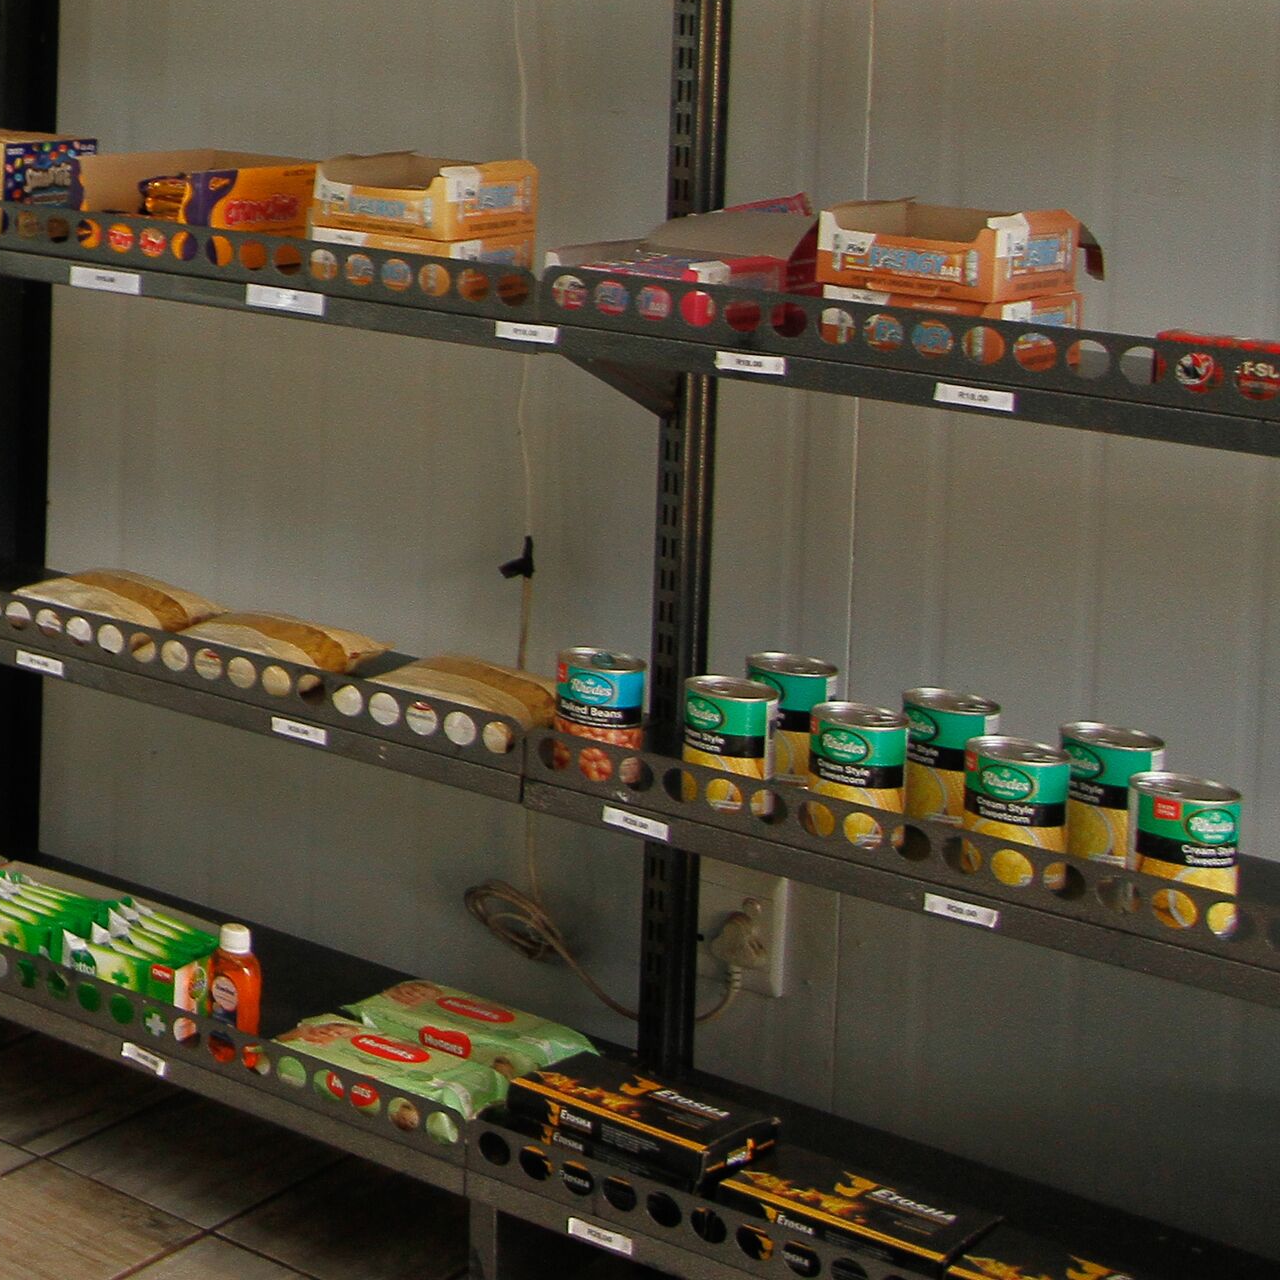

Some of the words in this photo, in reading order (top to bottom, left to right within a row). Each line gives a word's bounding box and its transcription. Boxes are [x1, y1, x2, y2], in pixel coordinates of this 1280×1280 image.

[870, 246, 947, 273] ENERGY
[590, 706, 624, 718] Beans
[822, 733, 867, 755] Rhodes
[845, 765, 870, 777] Style
[982, 770, 1030, 792] Rhodes
[976, 795, 1006, 810] Cream
[1008, 802, 1035, 816] Style
[979, 806, 1031, 824] Sweetcorn
[1189, 816, 1234, 833] Rhodes
[1181, 844, 1215, 856] Cream
